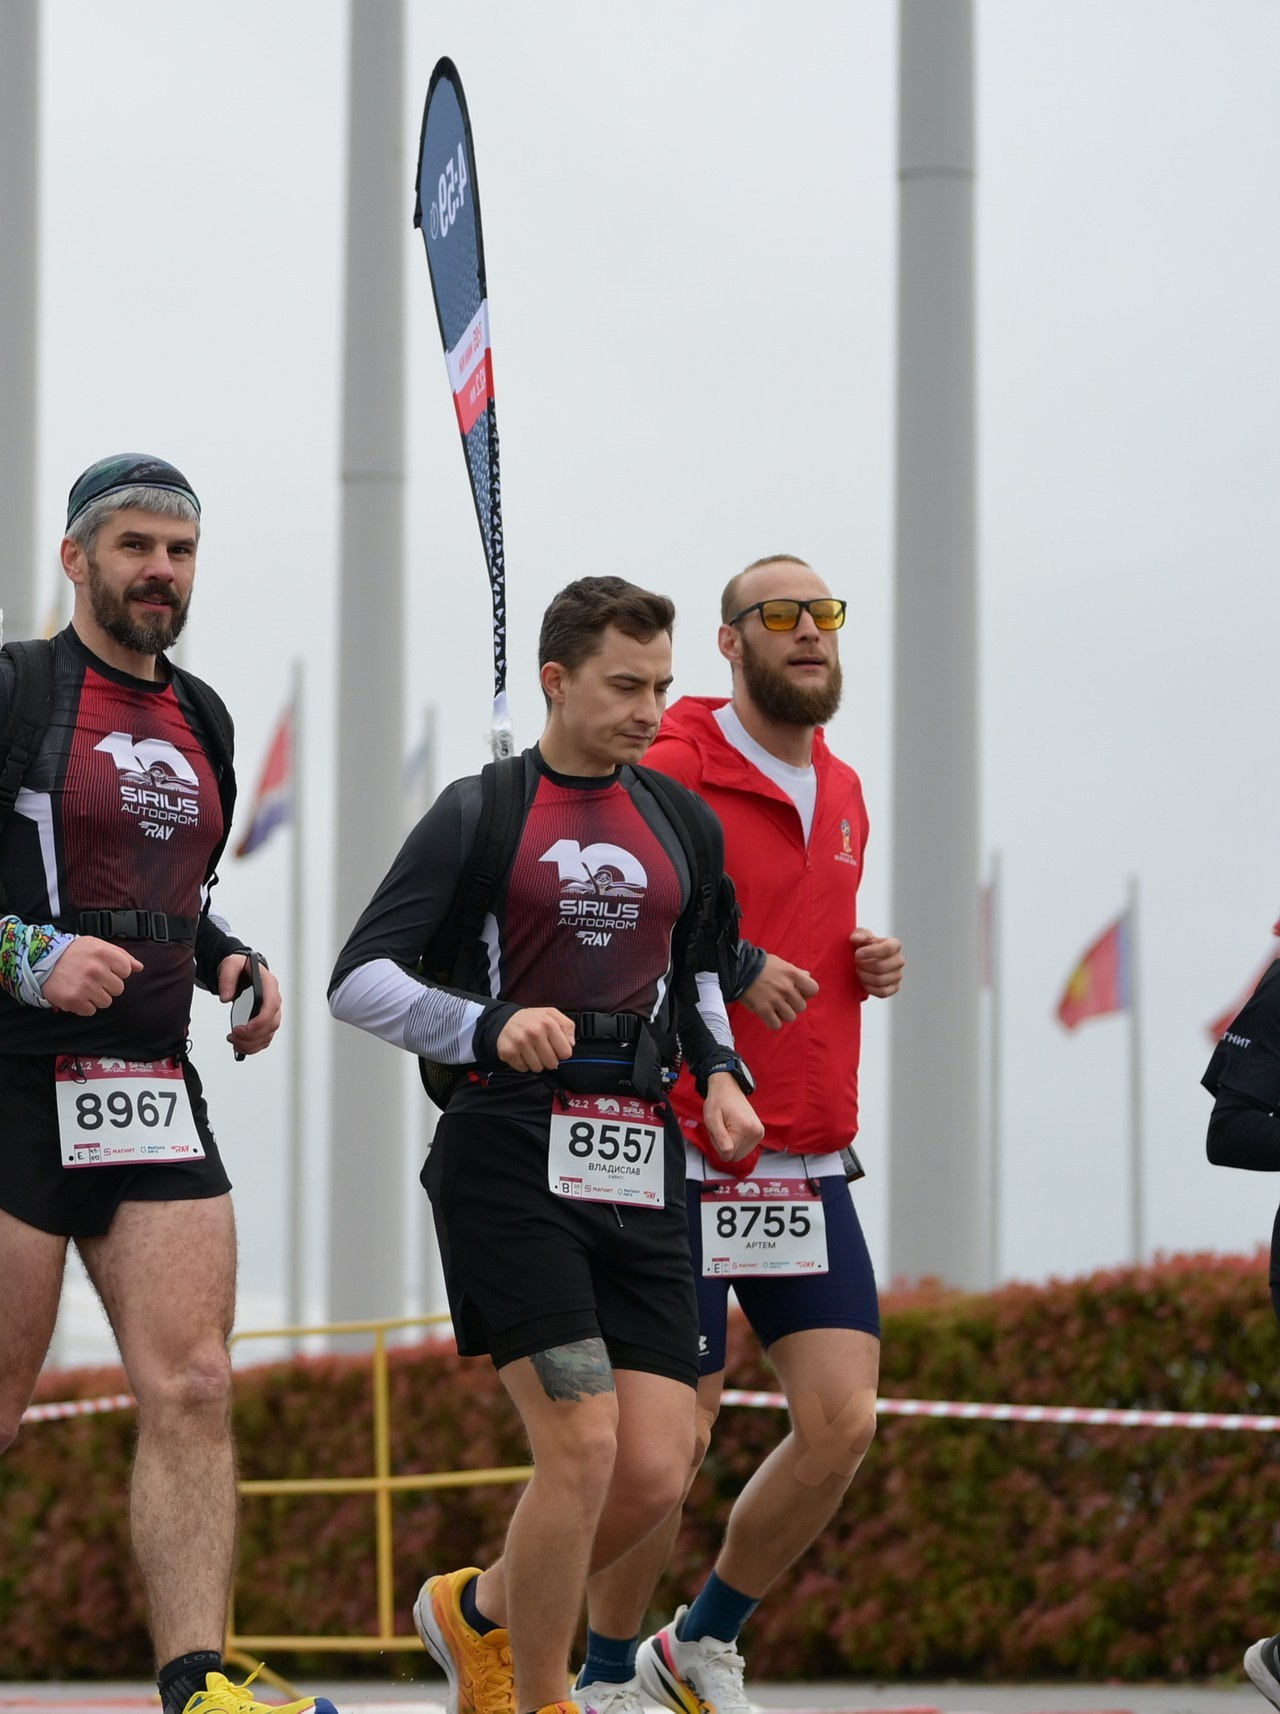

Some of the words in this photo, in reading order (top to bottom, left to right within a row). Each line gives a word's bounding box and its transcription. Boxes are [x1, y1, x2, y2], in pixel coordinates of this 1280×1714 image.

[120, 786, 200, 815] SIRIUS
[121, 803, 199, 827] AUTODROM
[559, 900, 640, 919] SIRIUS
[557, 917, 637, 931] AUTODROM
[1220, 1031, 1252, 1049] ГНИТ
[71, 1061, 93, 1073] 4.2
[75, 1090, 178, 1131] 8967
[568, 1098, 589, 1109] 42.2
[568, 1121, 656, 1165] 8557
[588, 1162, 641, 1175] ВЛАДИСЛАВ
[714, 1185, 731, 1194] 2.2
[716, 1205, 811, 1238] 8755
[745, 1241, 776, 1249] АРТЕМ
